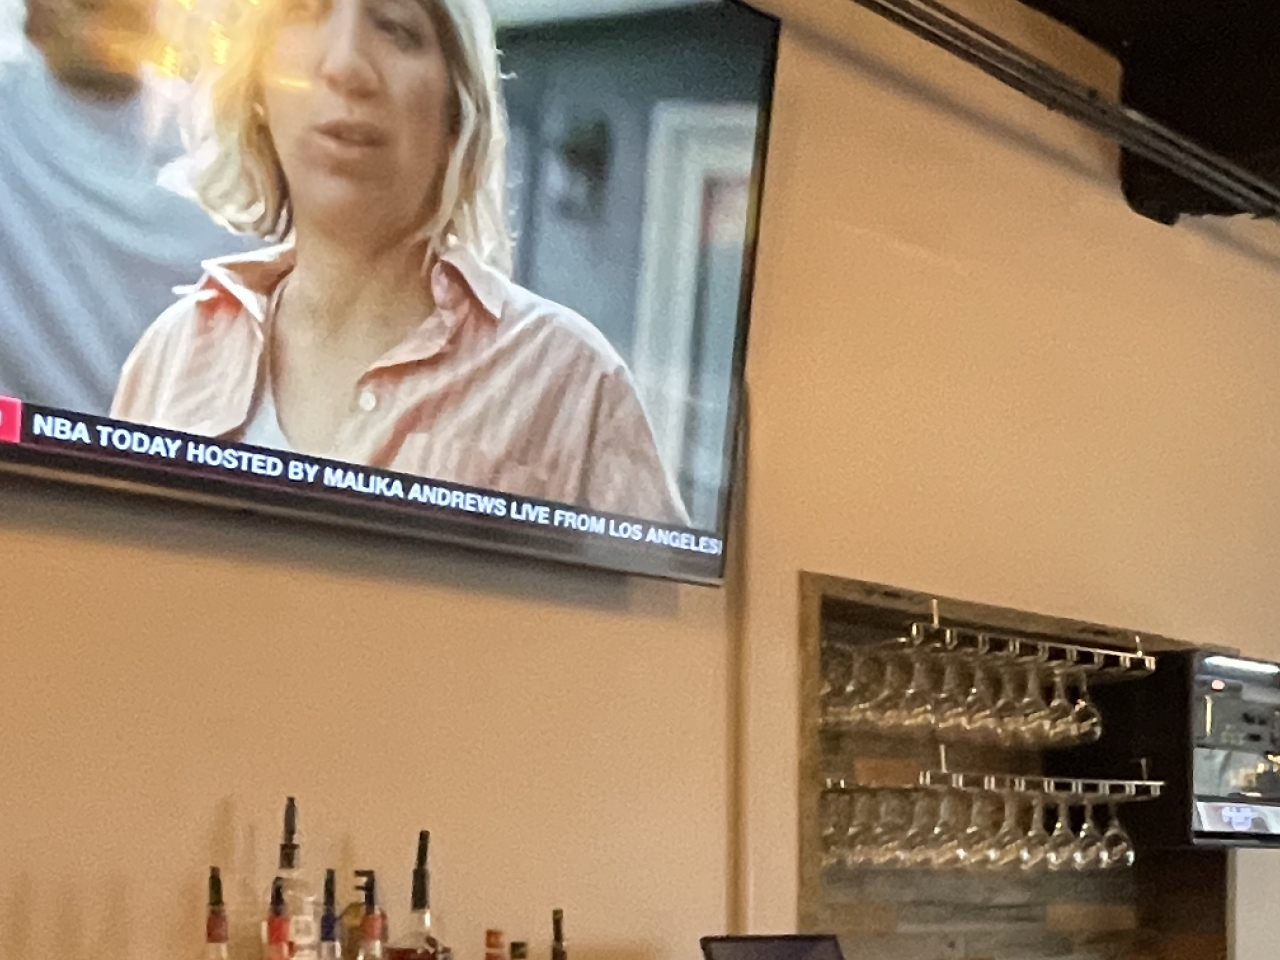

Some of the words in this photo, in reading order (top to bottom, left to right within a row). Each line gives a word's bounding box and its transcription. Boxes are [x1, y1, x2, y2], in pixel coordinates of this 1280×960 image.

[33, 413, 91, 444] NBA
[96, 425, 181, 459] TODAY
[186, 441, 283, 477] HOSTED
[288, 459, 319, 483] BY
[323, 466, 404, 499] MALIKA
[408, 482, 507, 517] ANDREWS
[510, 501, 550, 525] LIVE
[553, 509, 606, 535] FROM
[608, 519, 643, 541] LOS
[645, 526, 723, 557] ANGELES
